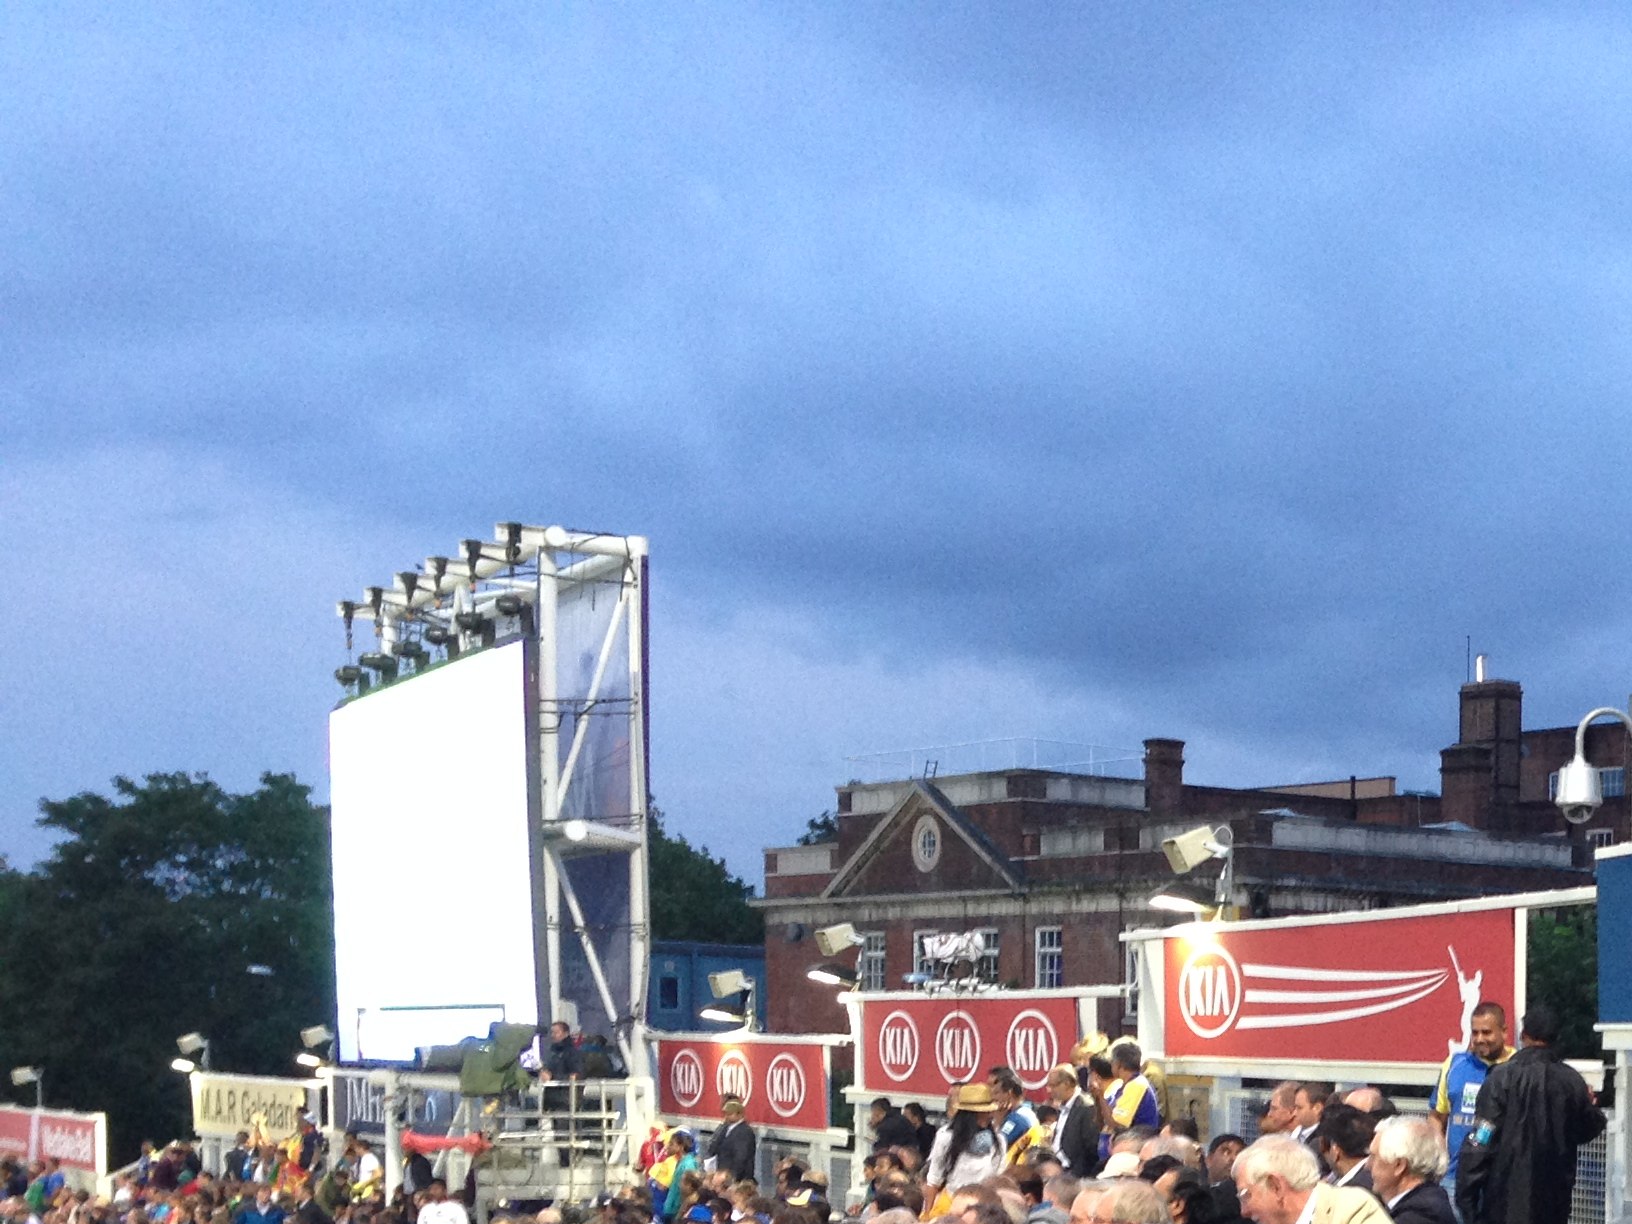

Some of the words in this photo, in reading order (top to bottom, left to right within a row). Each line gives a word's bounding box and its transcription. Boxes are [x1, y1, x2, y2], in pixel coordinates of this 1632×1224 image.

[1187, 965, 1230, 1017] KIA
[885, 1027, 912, 1066] KIA
[942, 1027, 973, 1069] KIA
[1014, 1027, 1049, 1072] KIA
[676, 1063, 697, 1094] KIA
[722, 1063, 747, 1099] KIA
[772, 1067, 799, 1103] KIA
